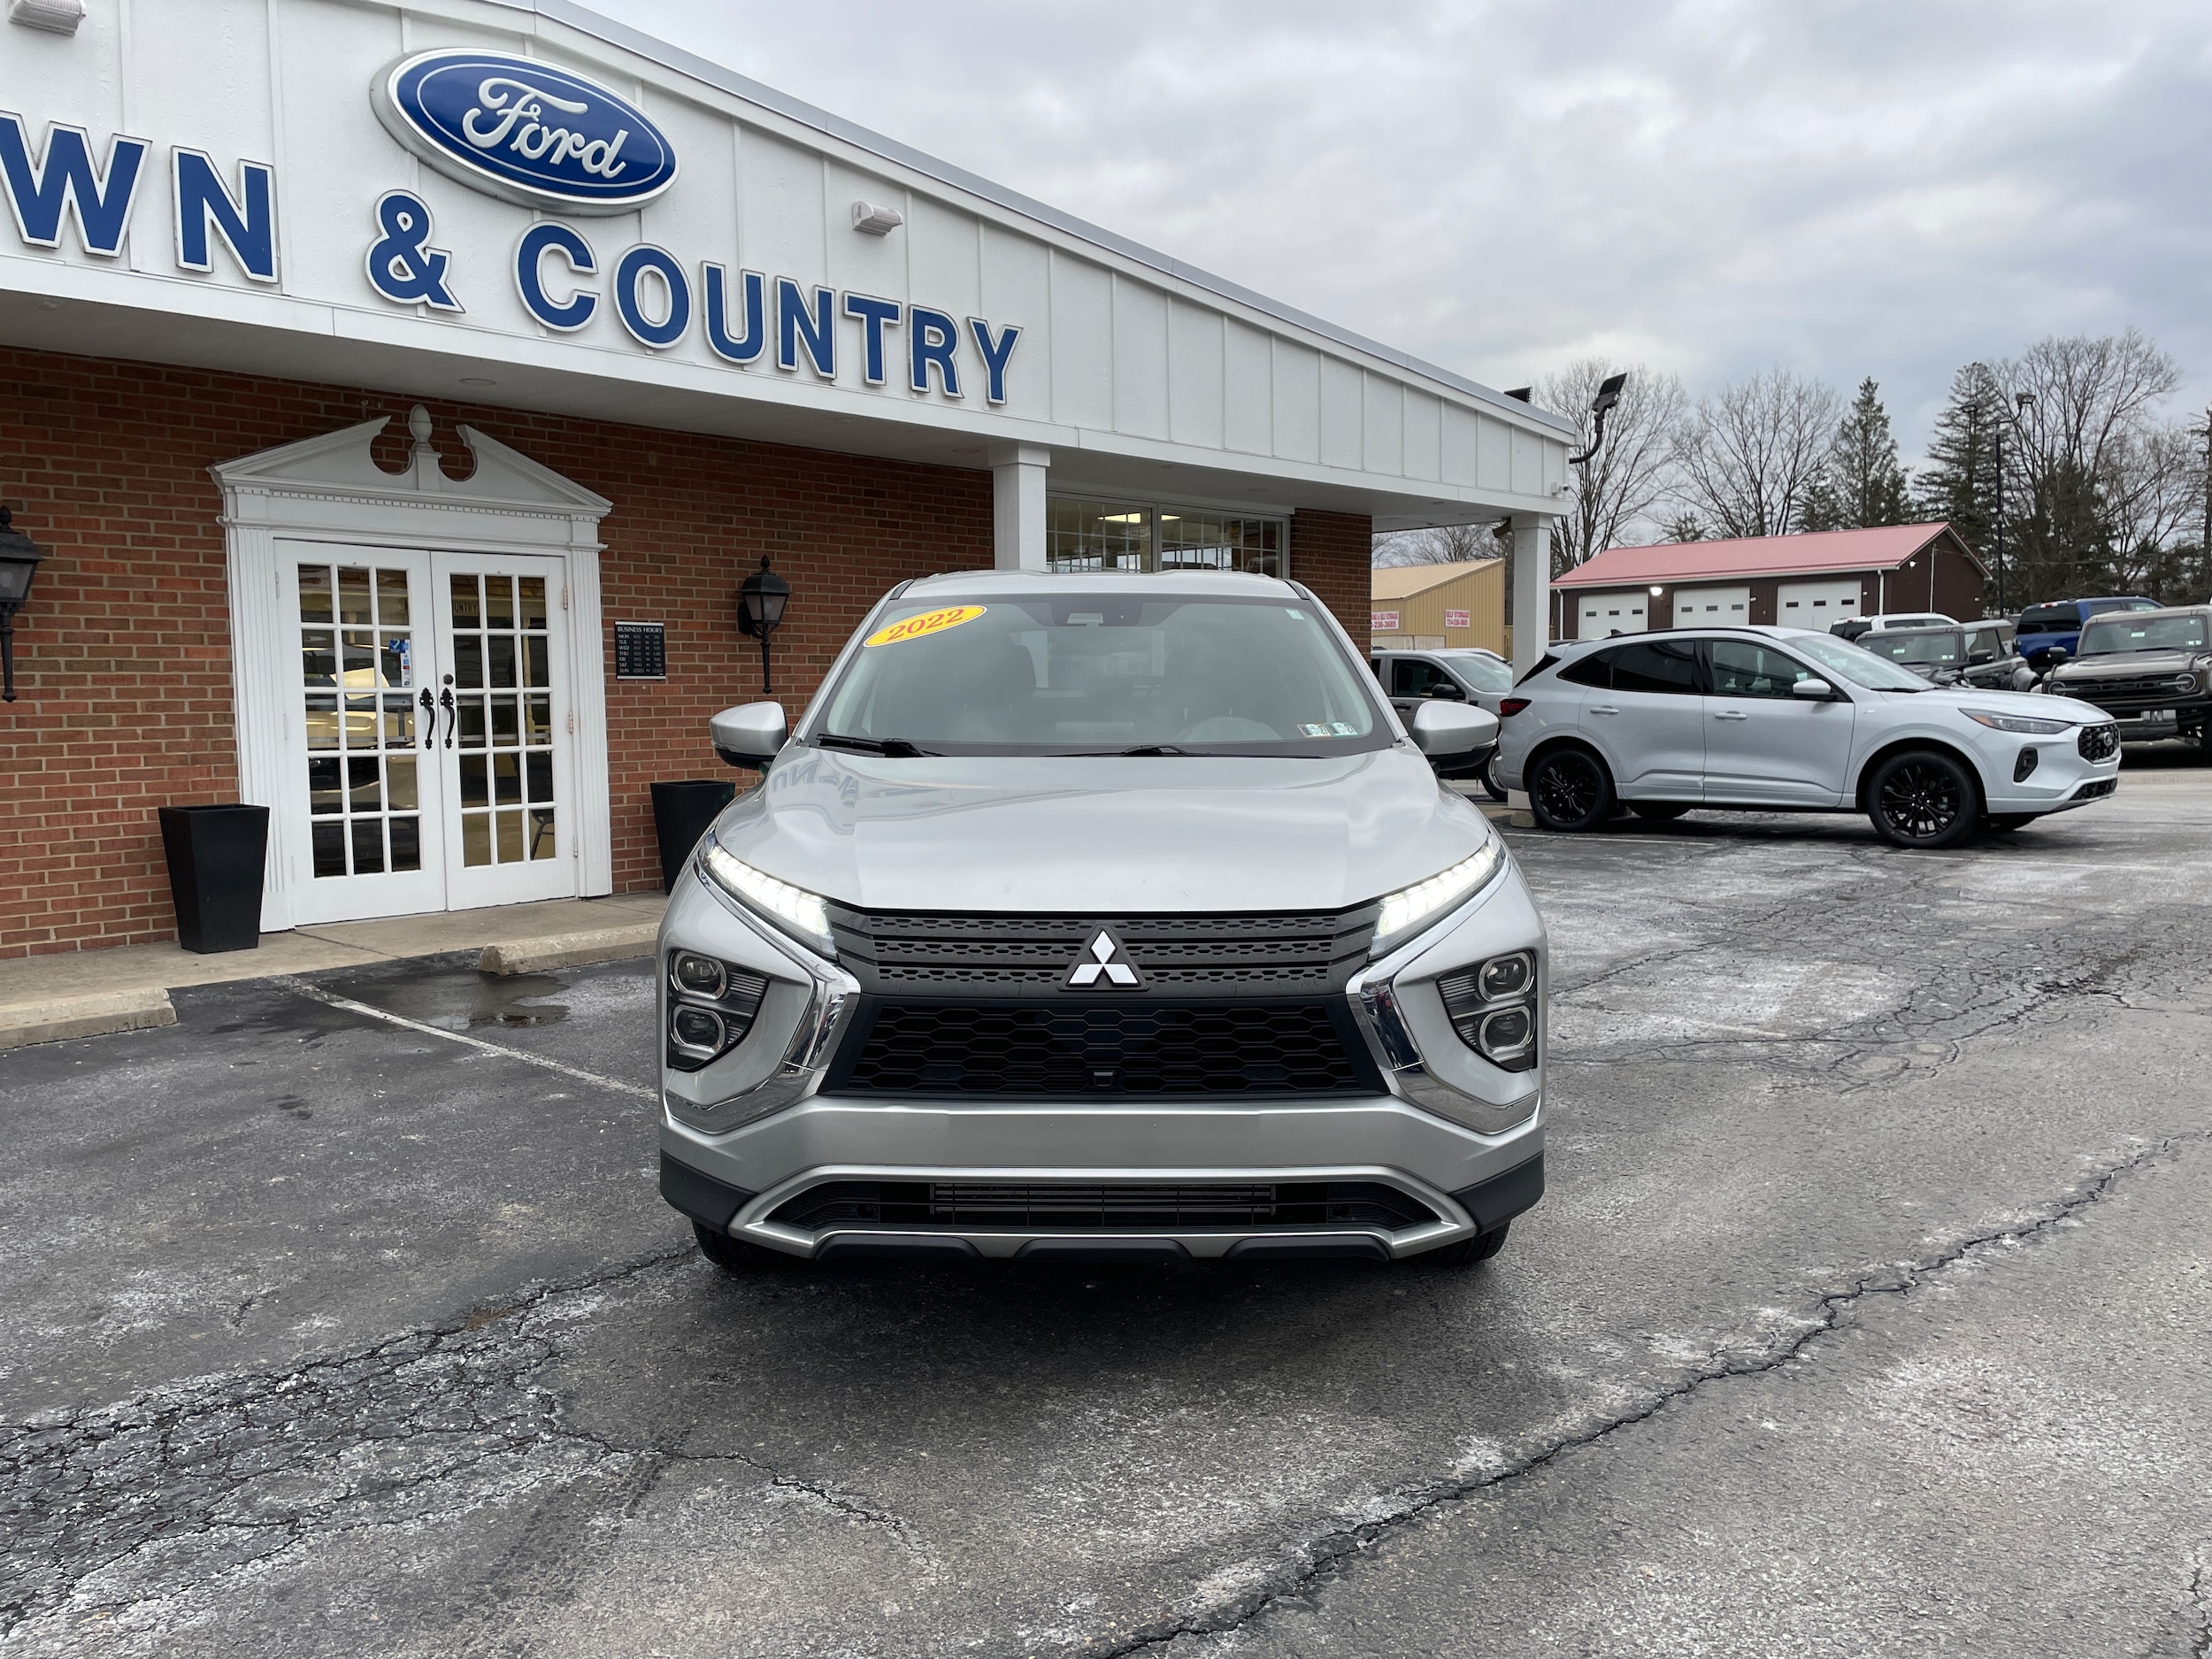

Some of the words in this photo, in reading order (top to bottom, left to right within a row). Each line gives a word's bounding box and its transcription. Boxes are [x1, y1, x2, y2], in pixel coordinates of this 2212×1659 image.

[463, 77, 629, 179] Ford
[365, 188, 466, 313] &
[511, 219, 1024, 406] COUNTRY
[886, 608, 964, 641] 2022
